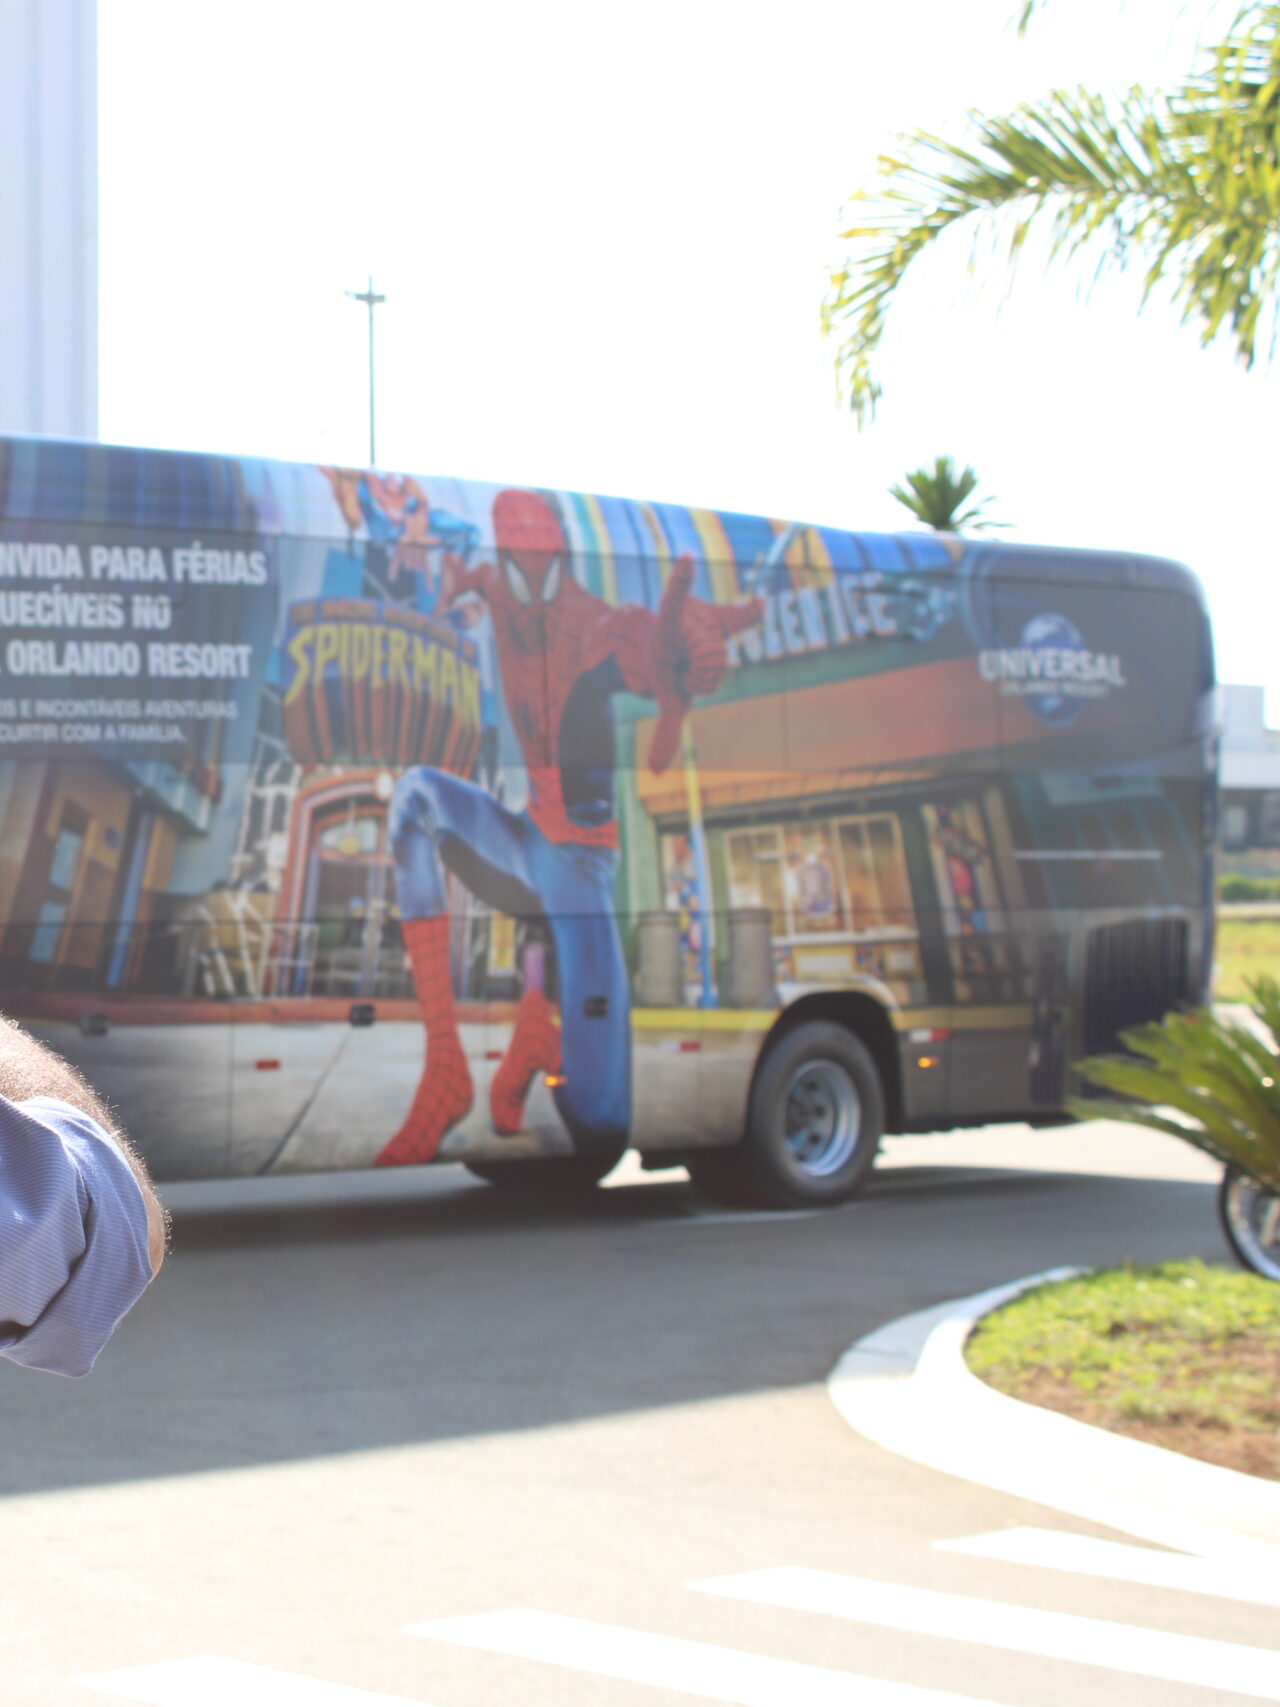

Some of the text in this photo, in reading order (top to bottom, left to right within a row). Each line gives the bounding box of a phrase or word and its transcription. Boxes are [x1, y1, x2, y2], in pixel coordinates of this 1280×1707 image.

[90, 546, 167, 582] PARA
[173, 541, 267, 585] FÉRIAS
[132, 594, 172, 630] NO
[6, 641, 141, 677] ORLANDO
[148, 644, 253, 678] RESORT
[978, 649, 1126, 686] UNIVERSAL
